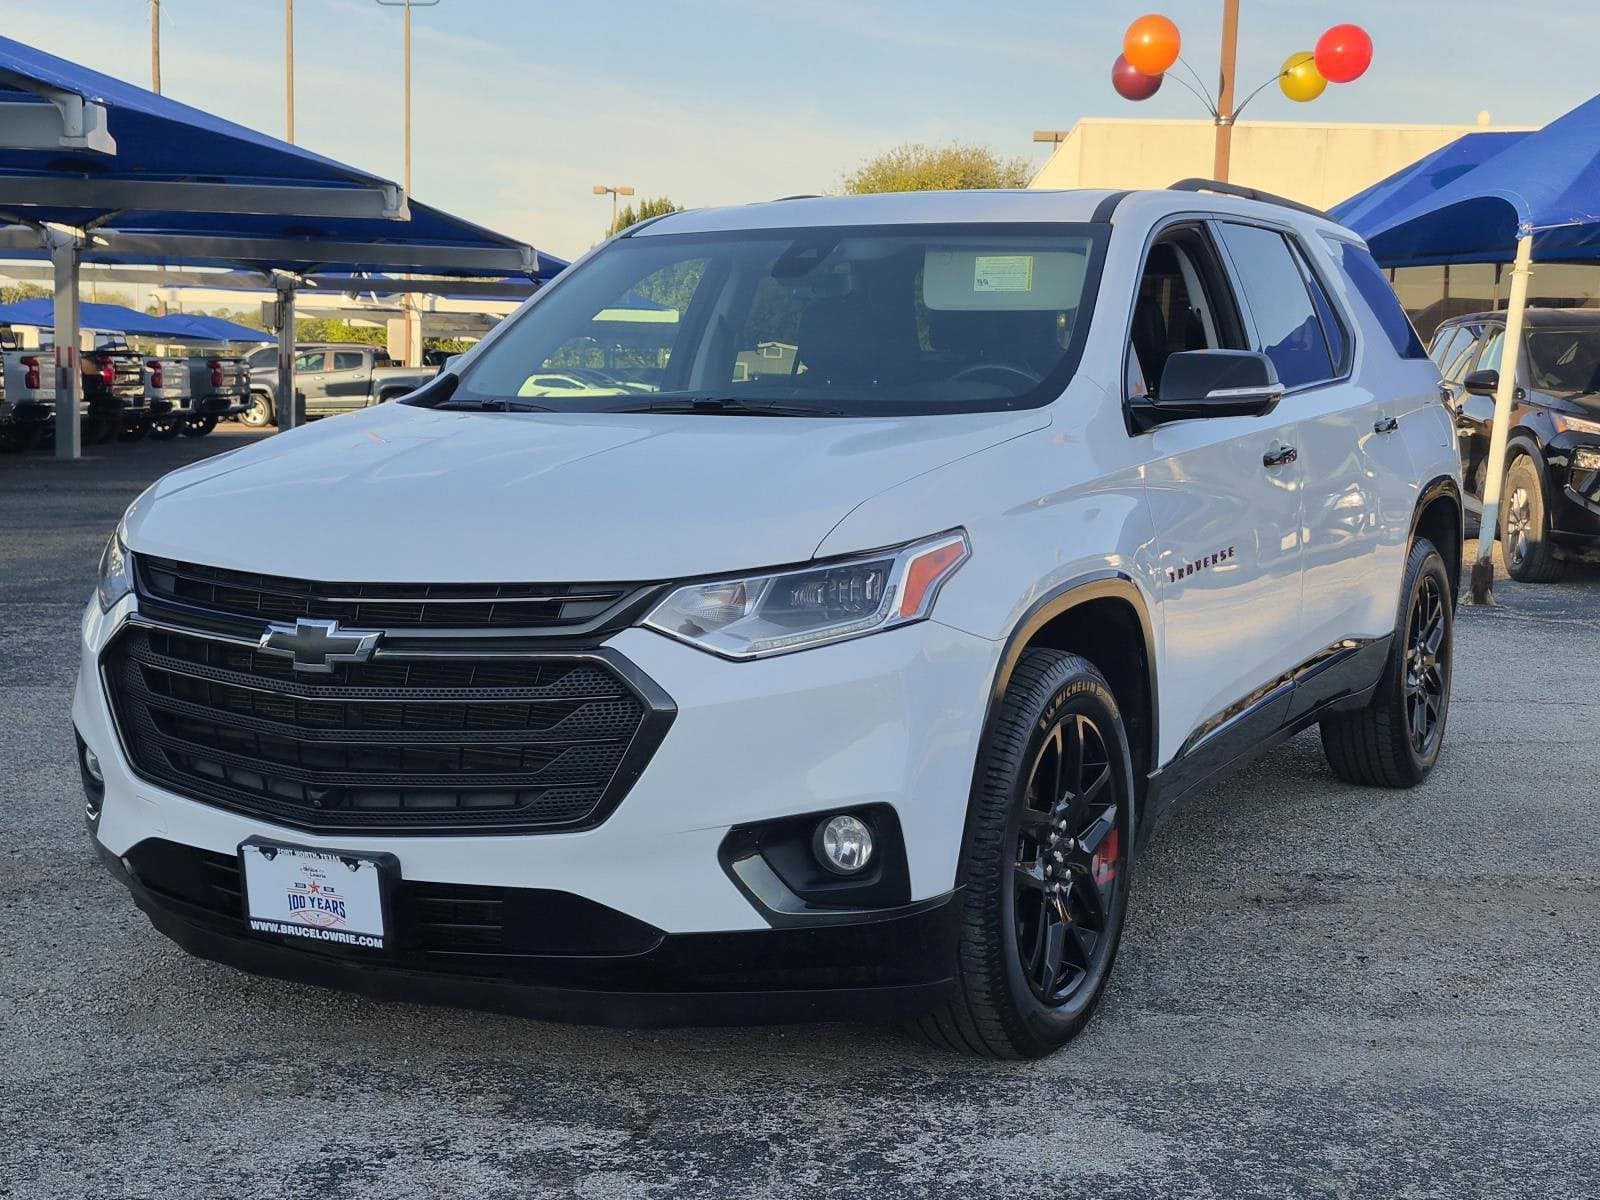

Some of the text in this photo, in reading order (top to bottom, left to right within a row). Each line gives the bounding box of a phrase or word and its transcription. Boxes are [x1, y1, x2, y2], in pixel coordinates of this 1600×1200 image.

[1169, 546, 1234, 583] TRAVERSE
[1055, 680, 1097, 709] MICHELIN
[288, 893, 346, 919] 100 YEARS
[250, 920, 384, 949] WWW.BRUCELOWRIE.COM
